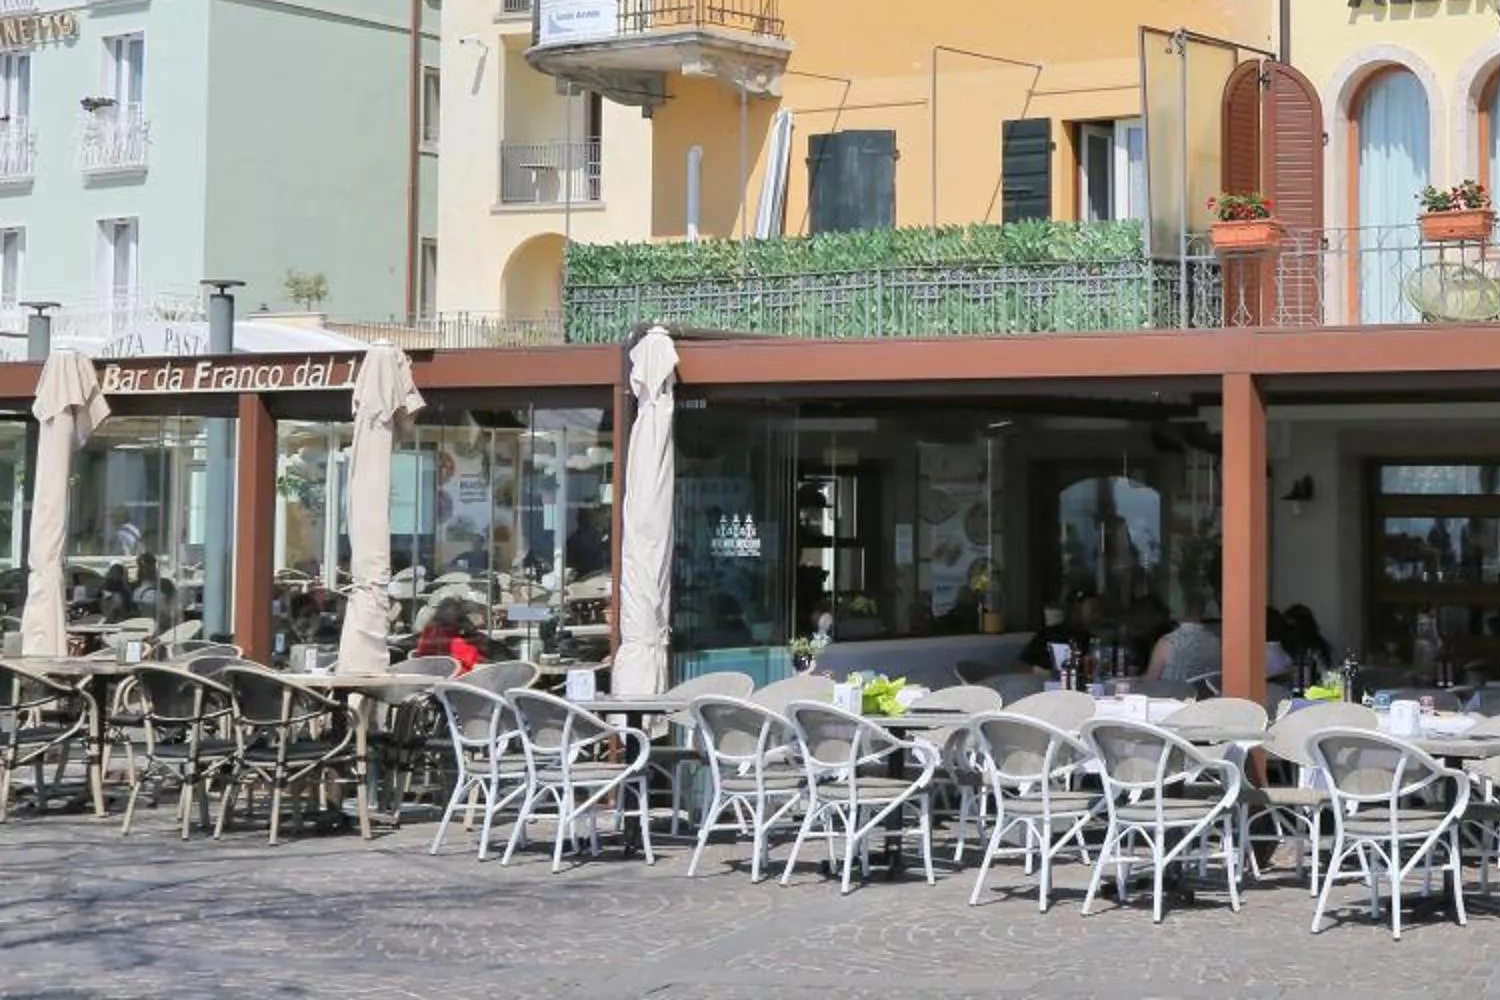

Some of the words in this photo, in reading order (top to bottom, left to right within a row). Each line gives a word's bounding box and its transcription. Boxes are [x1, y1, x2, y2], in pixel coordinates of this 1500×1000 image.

[103, 365, 148, 391] Bar
[154, 362, 184, 389] da
[193, 361, 283, 389] Franco
[293, 356, 333, 386] dal
